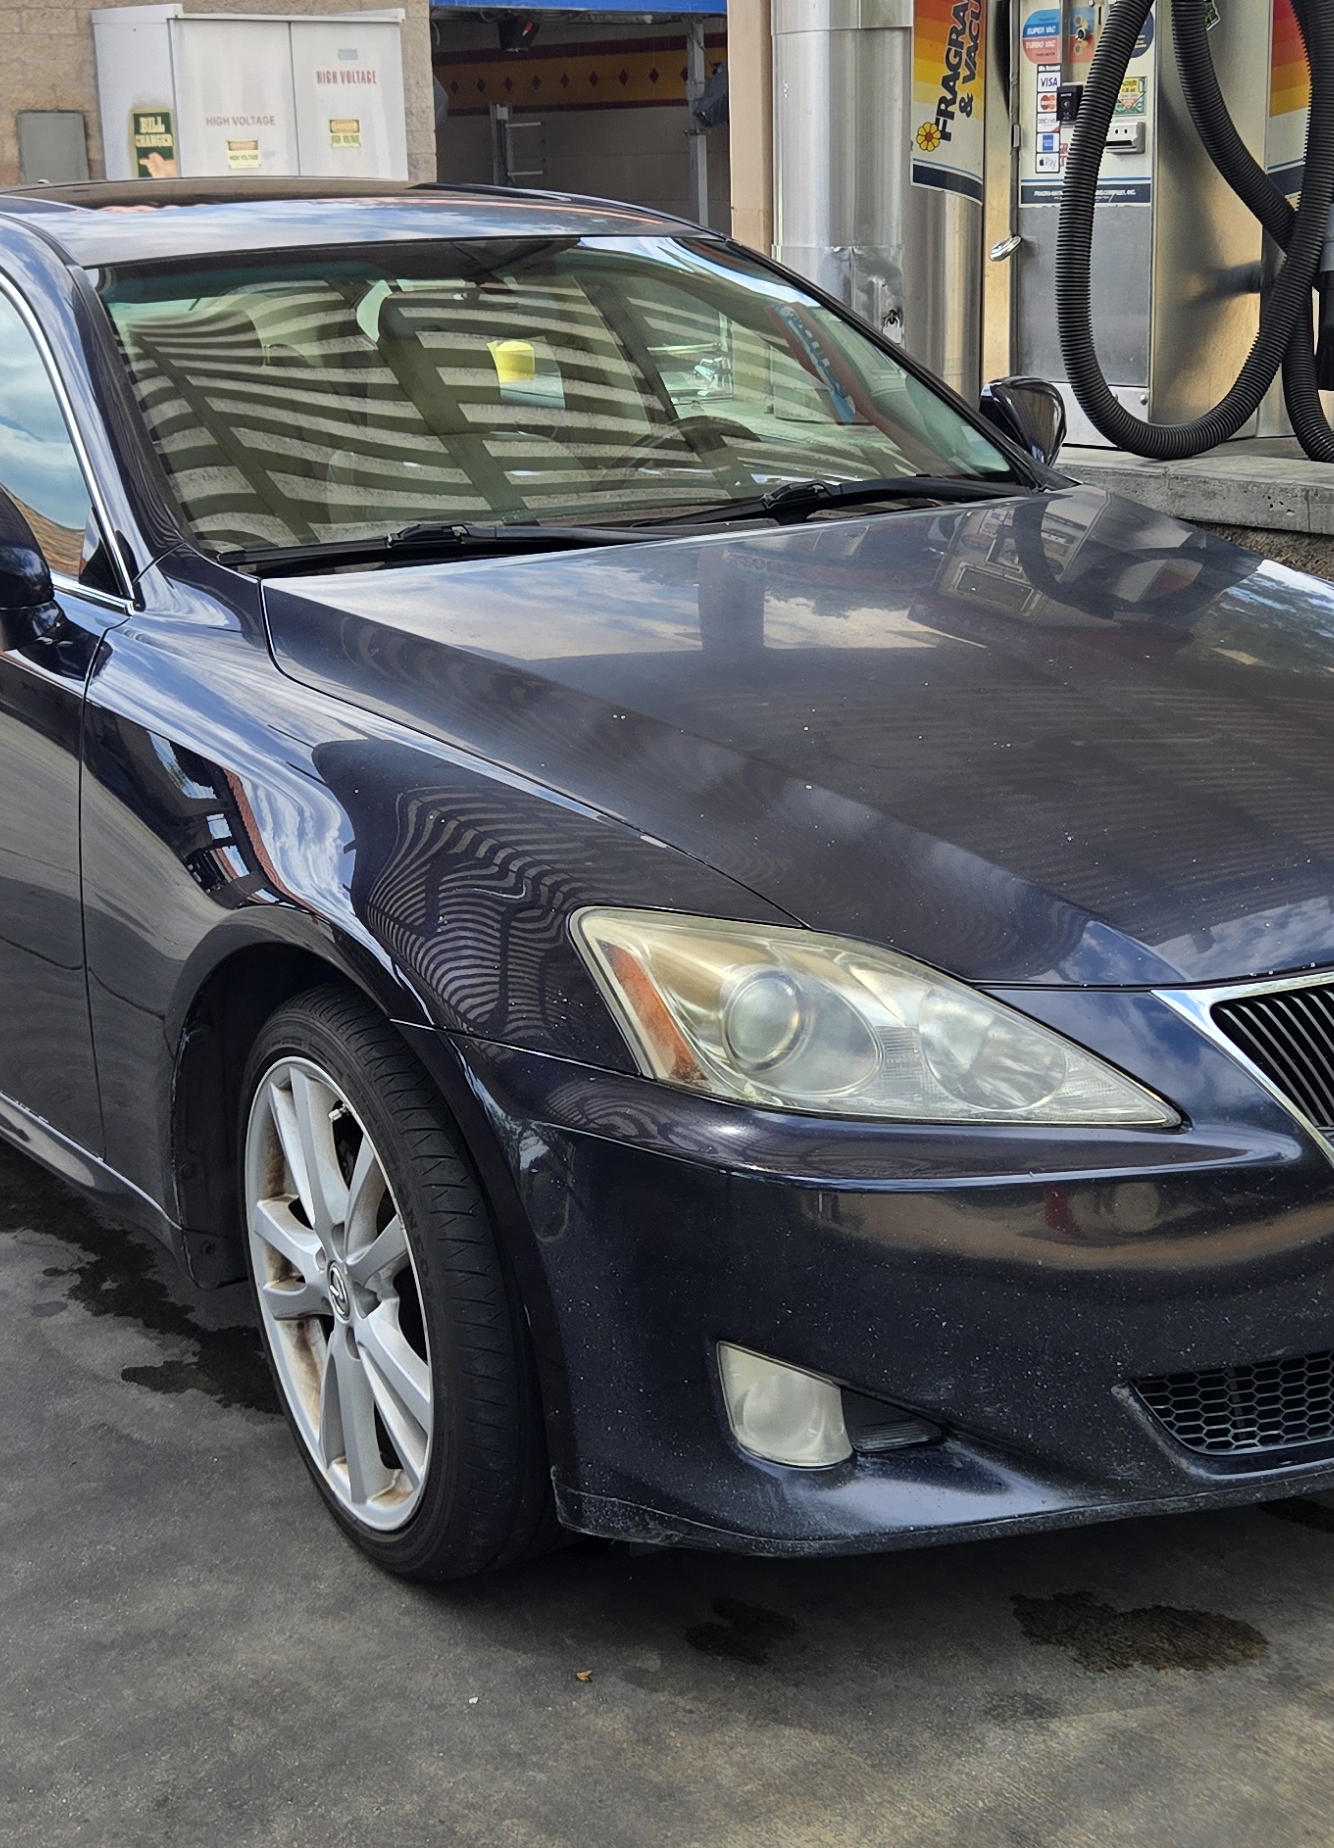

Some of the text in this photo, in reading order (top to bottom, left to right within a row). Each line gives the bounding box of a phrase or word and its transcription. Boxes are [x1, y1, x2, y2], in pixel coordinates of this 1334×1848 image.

[316, 70, 377, 85] HIGH VOLTAGE
[1040, 79, 1058, 90] VISA
[959, 93, 974, 118] &
[139, 116, 166, 133] BILL
[205, 115, 276, 127] HIGH VOLTAGE
[135, 133, 173, 148] CHANGER
